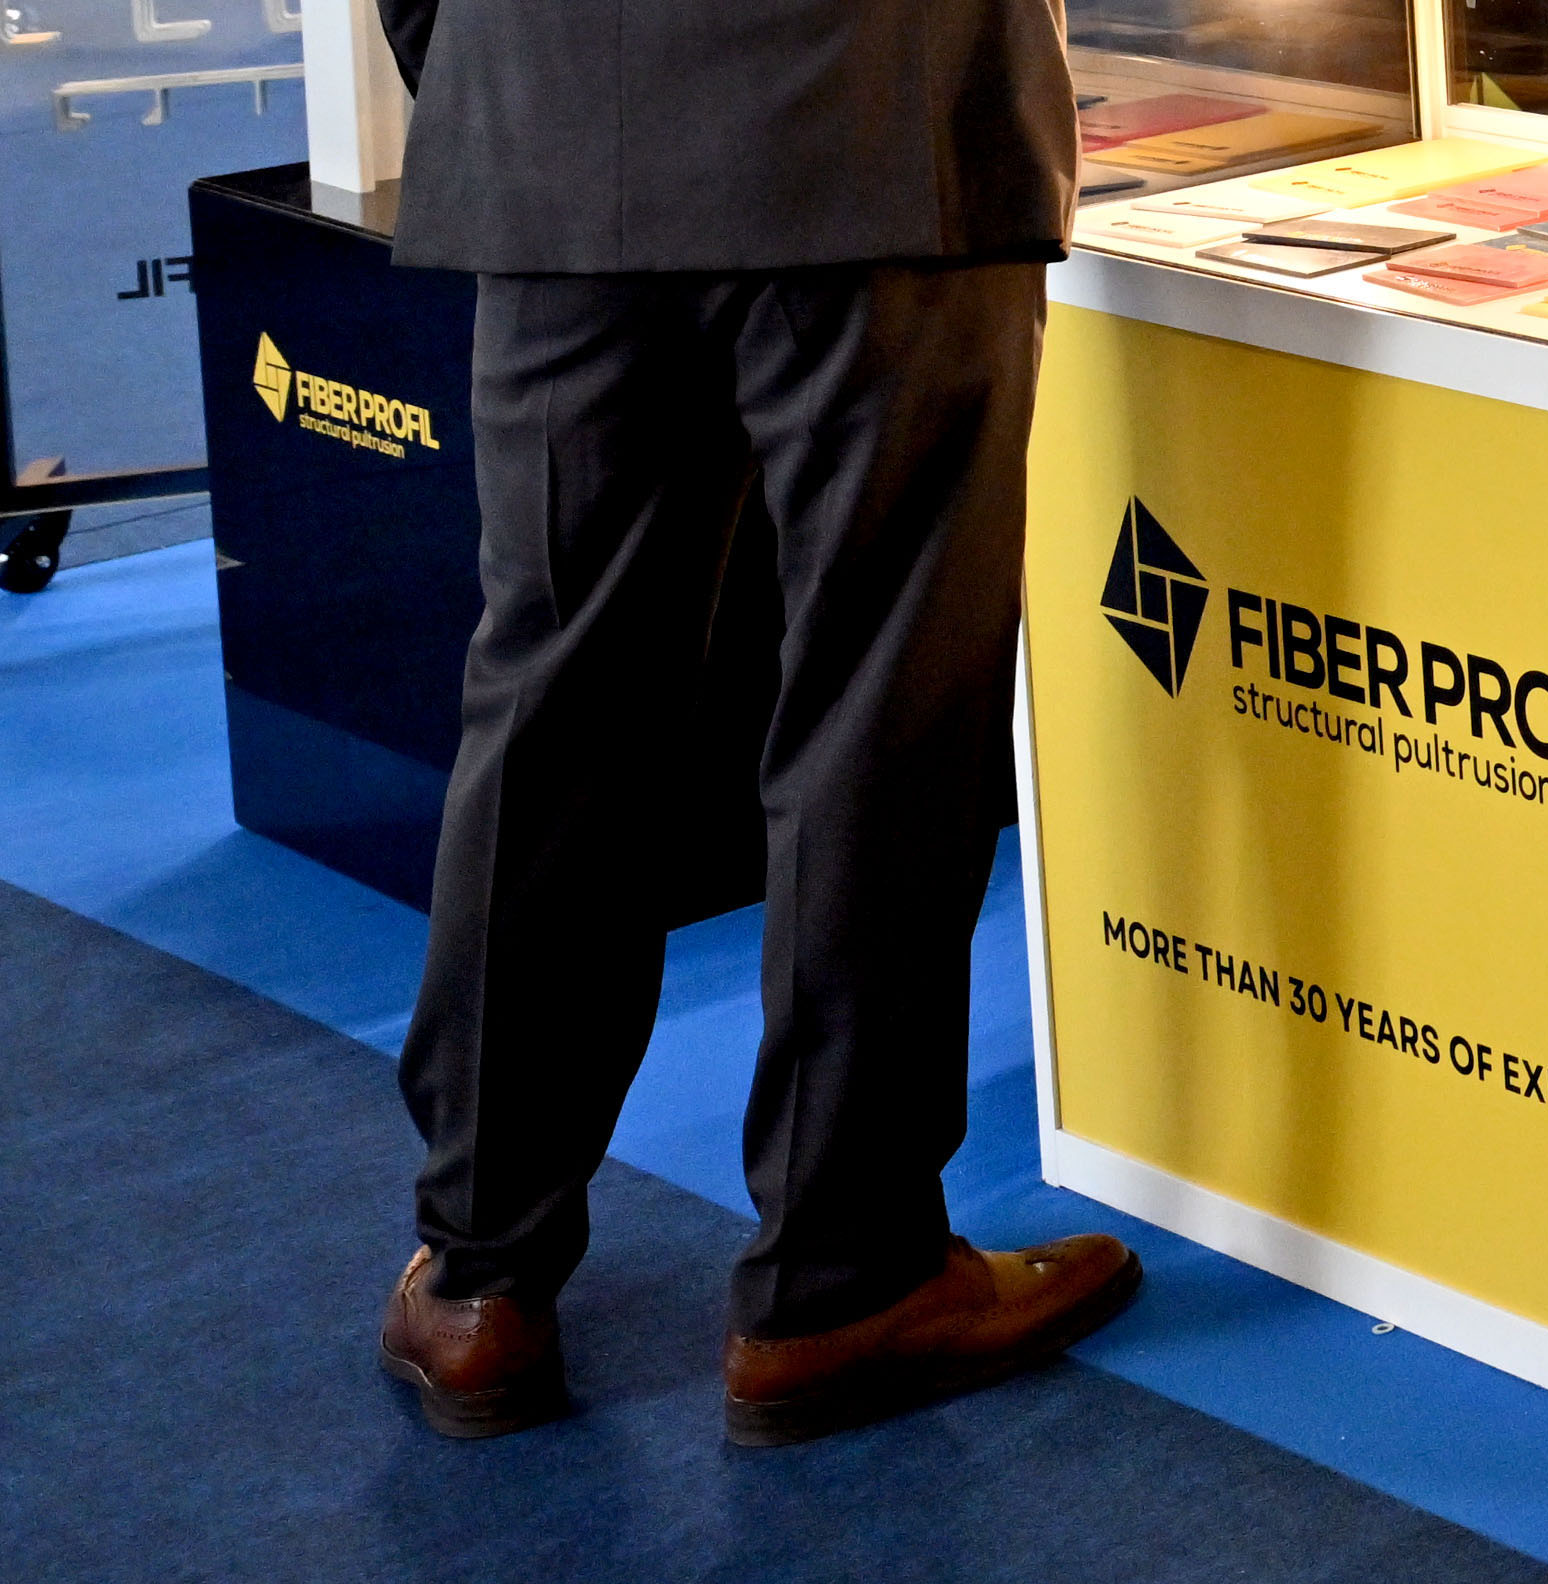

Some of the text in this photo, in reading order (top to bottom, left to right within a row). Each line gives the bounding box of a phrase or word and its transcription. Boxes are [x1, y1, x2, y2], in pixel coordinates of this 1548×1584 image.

[295, 370, 440, 450] FIBER PROFIL
[299, 413, 405, 458] structural pultrusion
[1227, 588, 1414, 716] FIBER
[1232, 682, 1386, 756] structural
[1103, 911, 1189, 976] MORE
[1194, 943, 1281, 1008] THAN
[1288, 976, 1328, 1024] 30
[1335, 992, 1442, 1066] YEARS
[1449, 1035, 1494, 1083] OF
